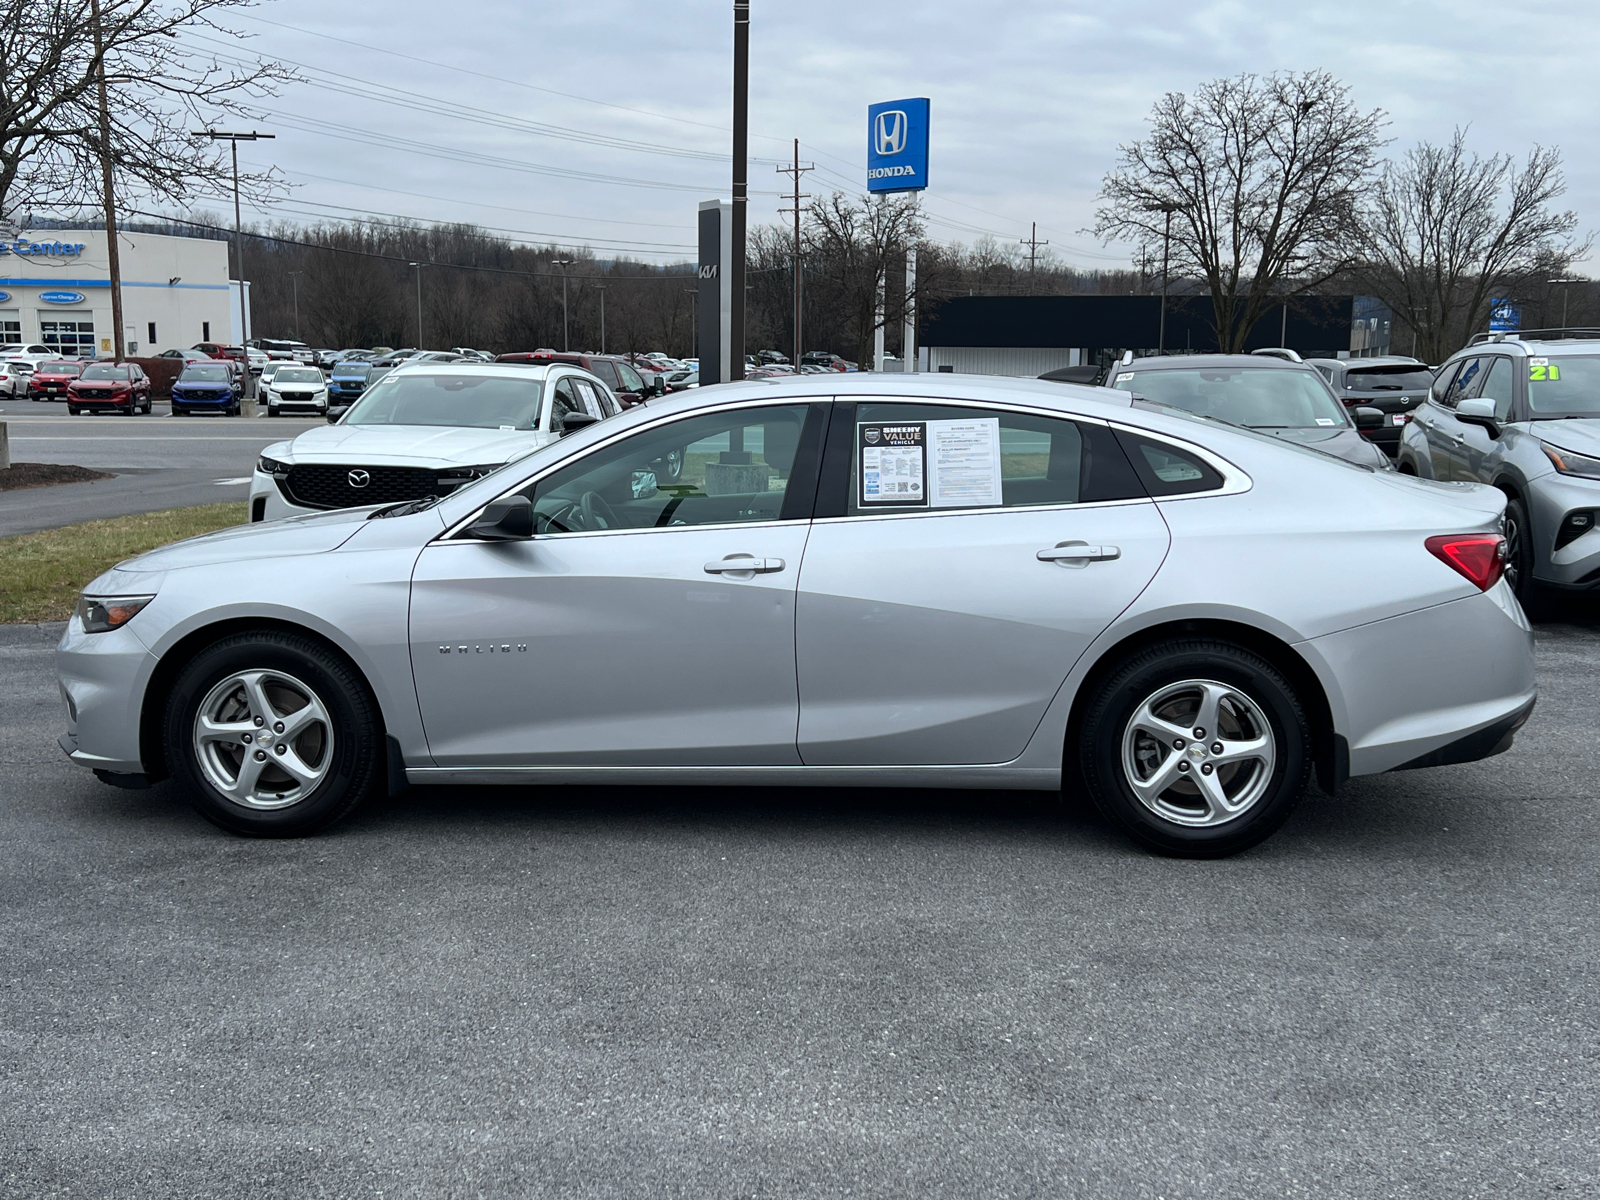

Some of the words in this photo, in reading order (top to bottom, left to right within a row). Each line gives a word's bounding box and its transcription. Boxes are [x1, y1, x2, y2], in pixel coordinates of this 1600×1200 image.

[868, 165, 916, 179] HONDA
[13, 239, 85, 255] Center
[699, 265, 718, 279] KIA
[1530, 365, 1560, 380] 21
[439, 644, 527, 654] MALIBU
